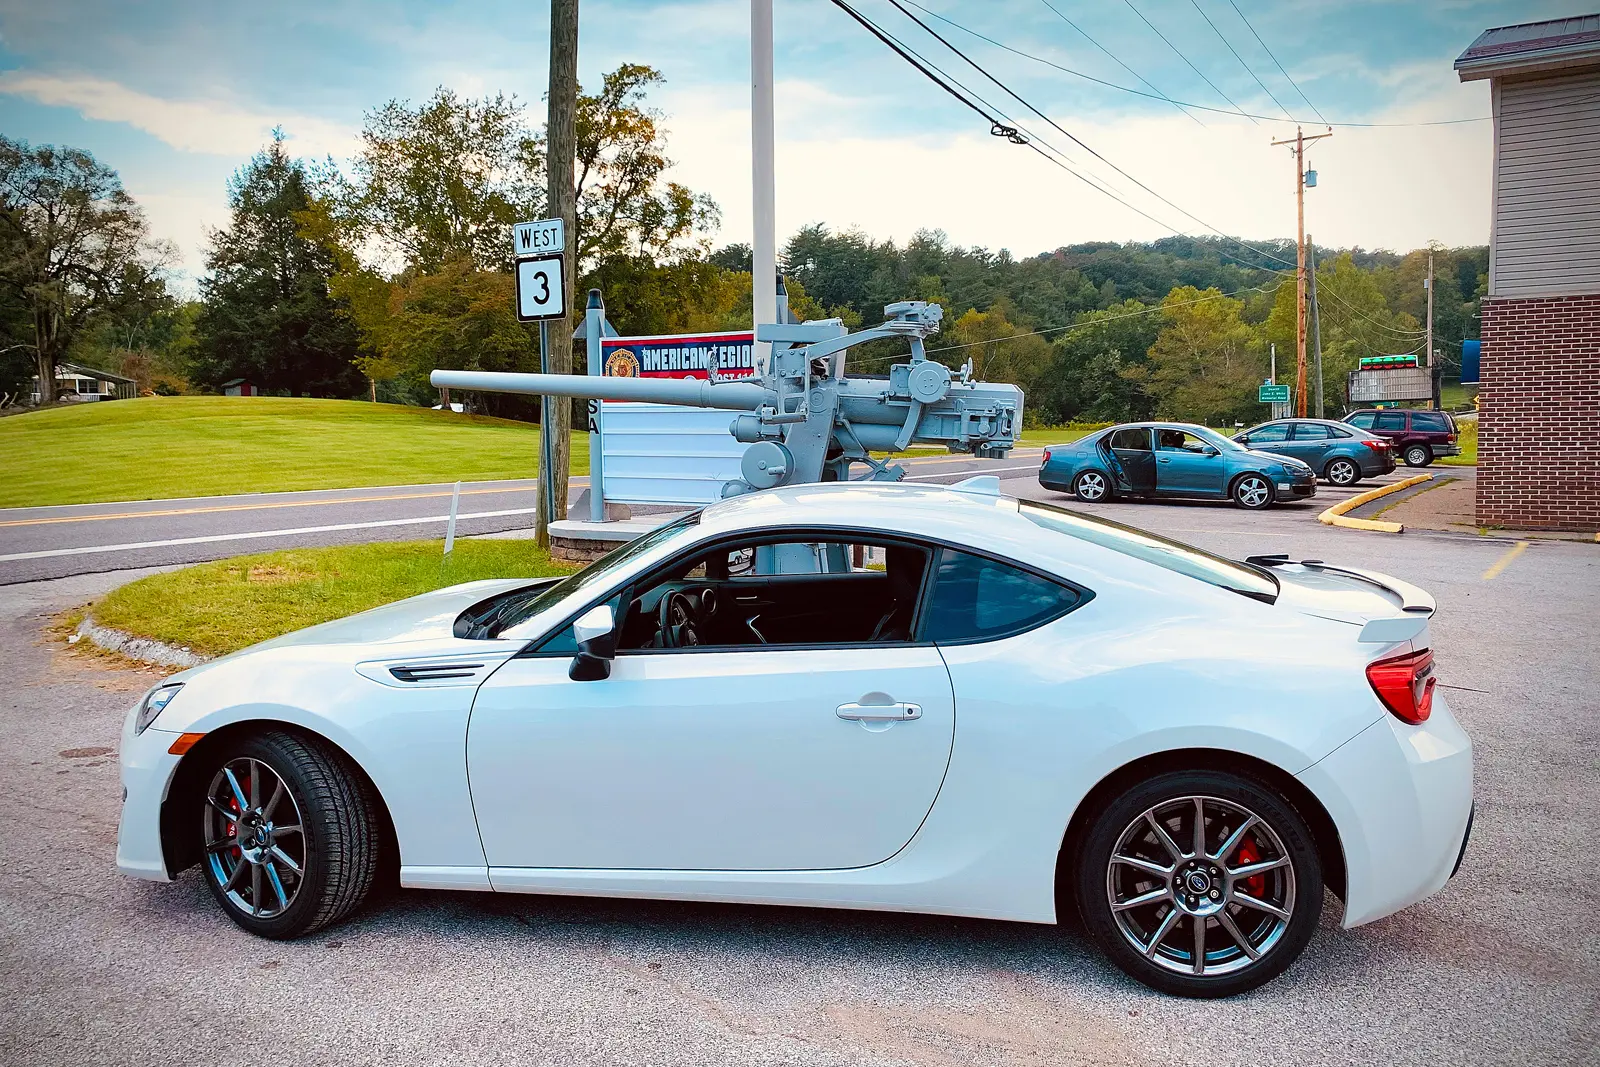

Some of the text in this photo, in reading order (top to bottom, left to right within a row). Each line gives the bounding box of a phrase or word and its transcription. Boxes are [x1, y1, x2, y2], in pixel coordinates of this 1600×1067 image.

[520, 228, 558, 249] WEST
[533, 271, 550, 305] 3
[642, 347, 708, 371] AMERICAN
[713, 344, 755, 369] EGIO
